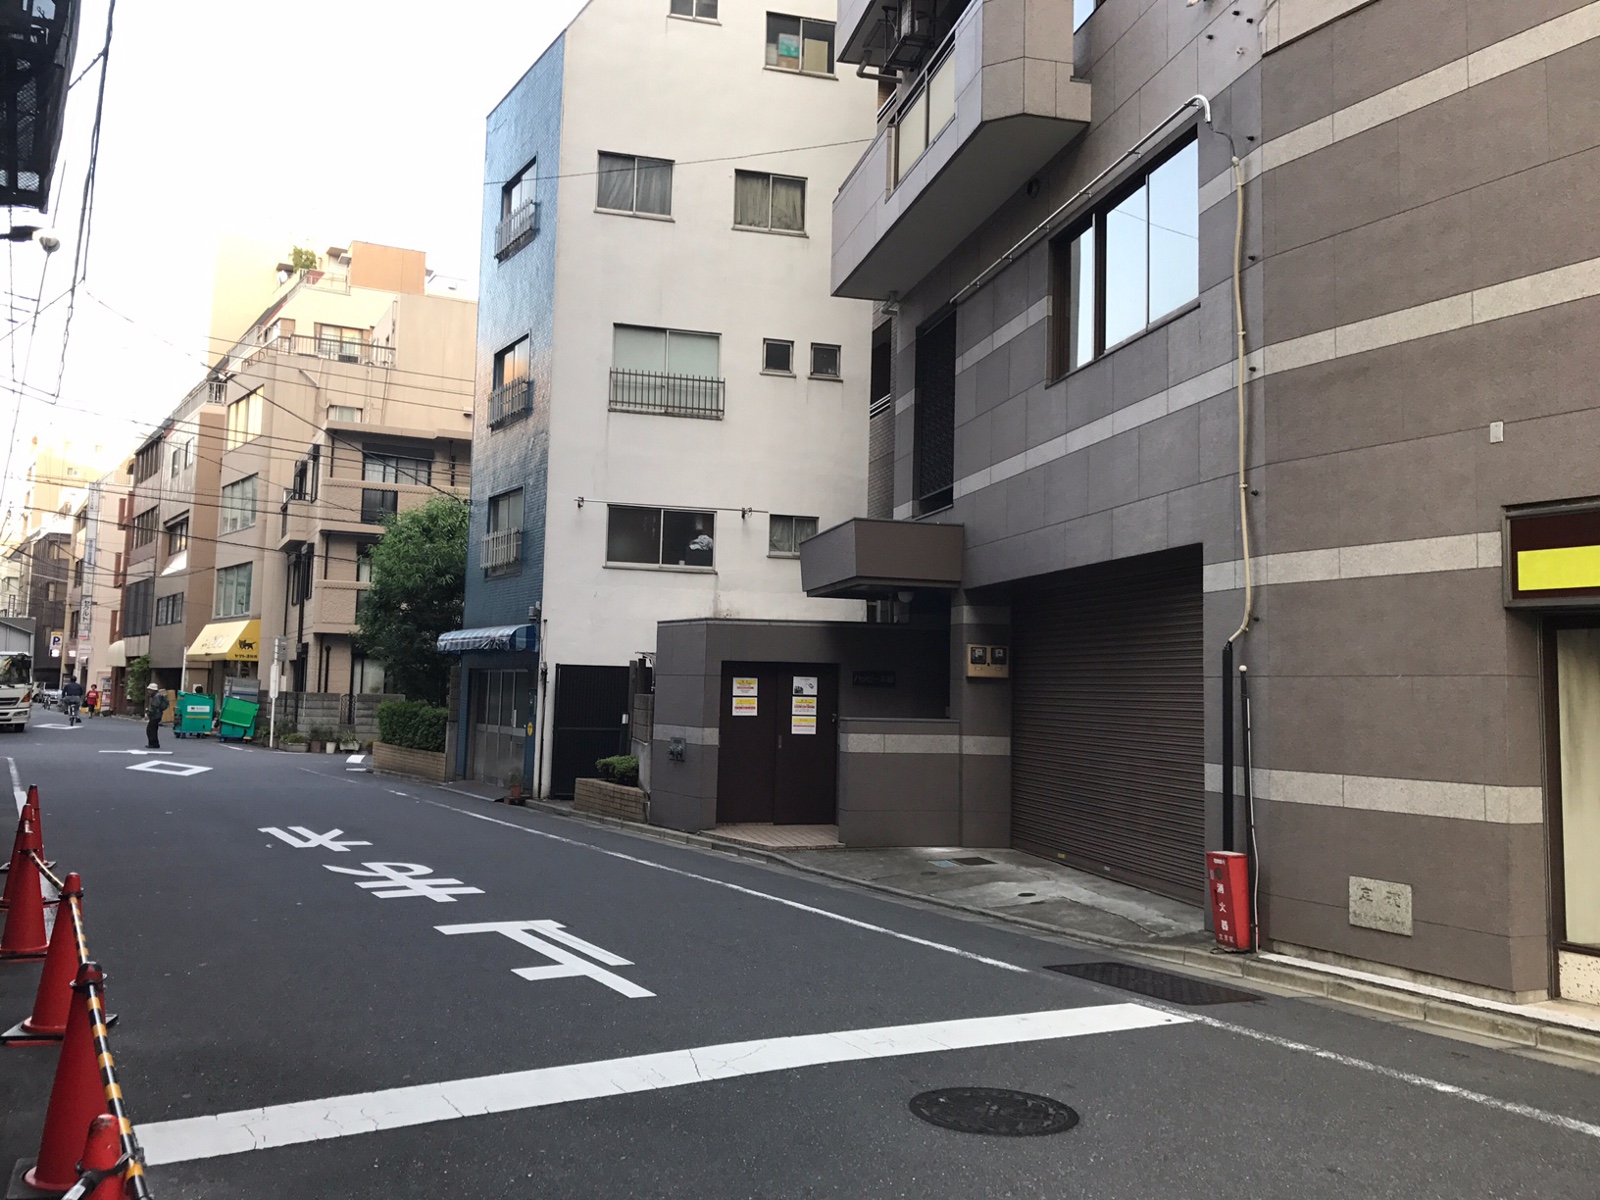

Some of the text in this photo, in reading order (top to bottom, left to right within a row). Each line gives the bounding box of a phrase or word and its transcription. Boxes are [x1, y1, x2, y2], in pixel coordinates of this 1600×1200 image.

[52, 636, 60, 645] P
[1216, 882, 1229, 931] 消火器
